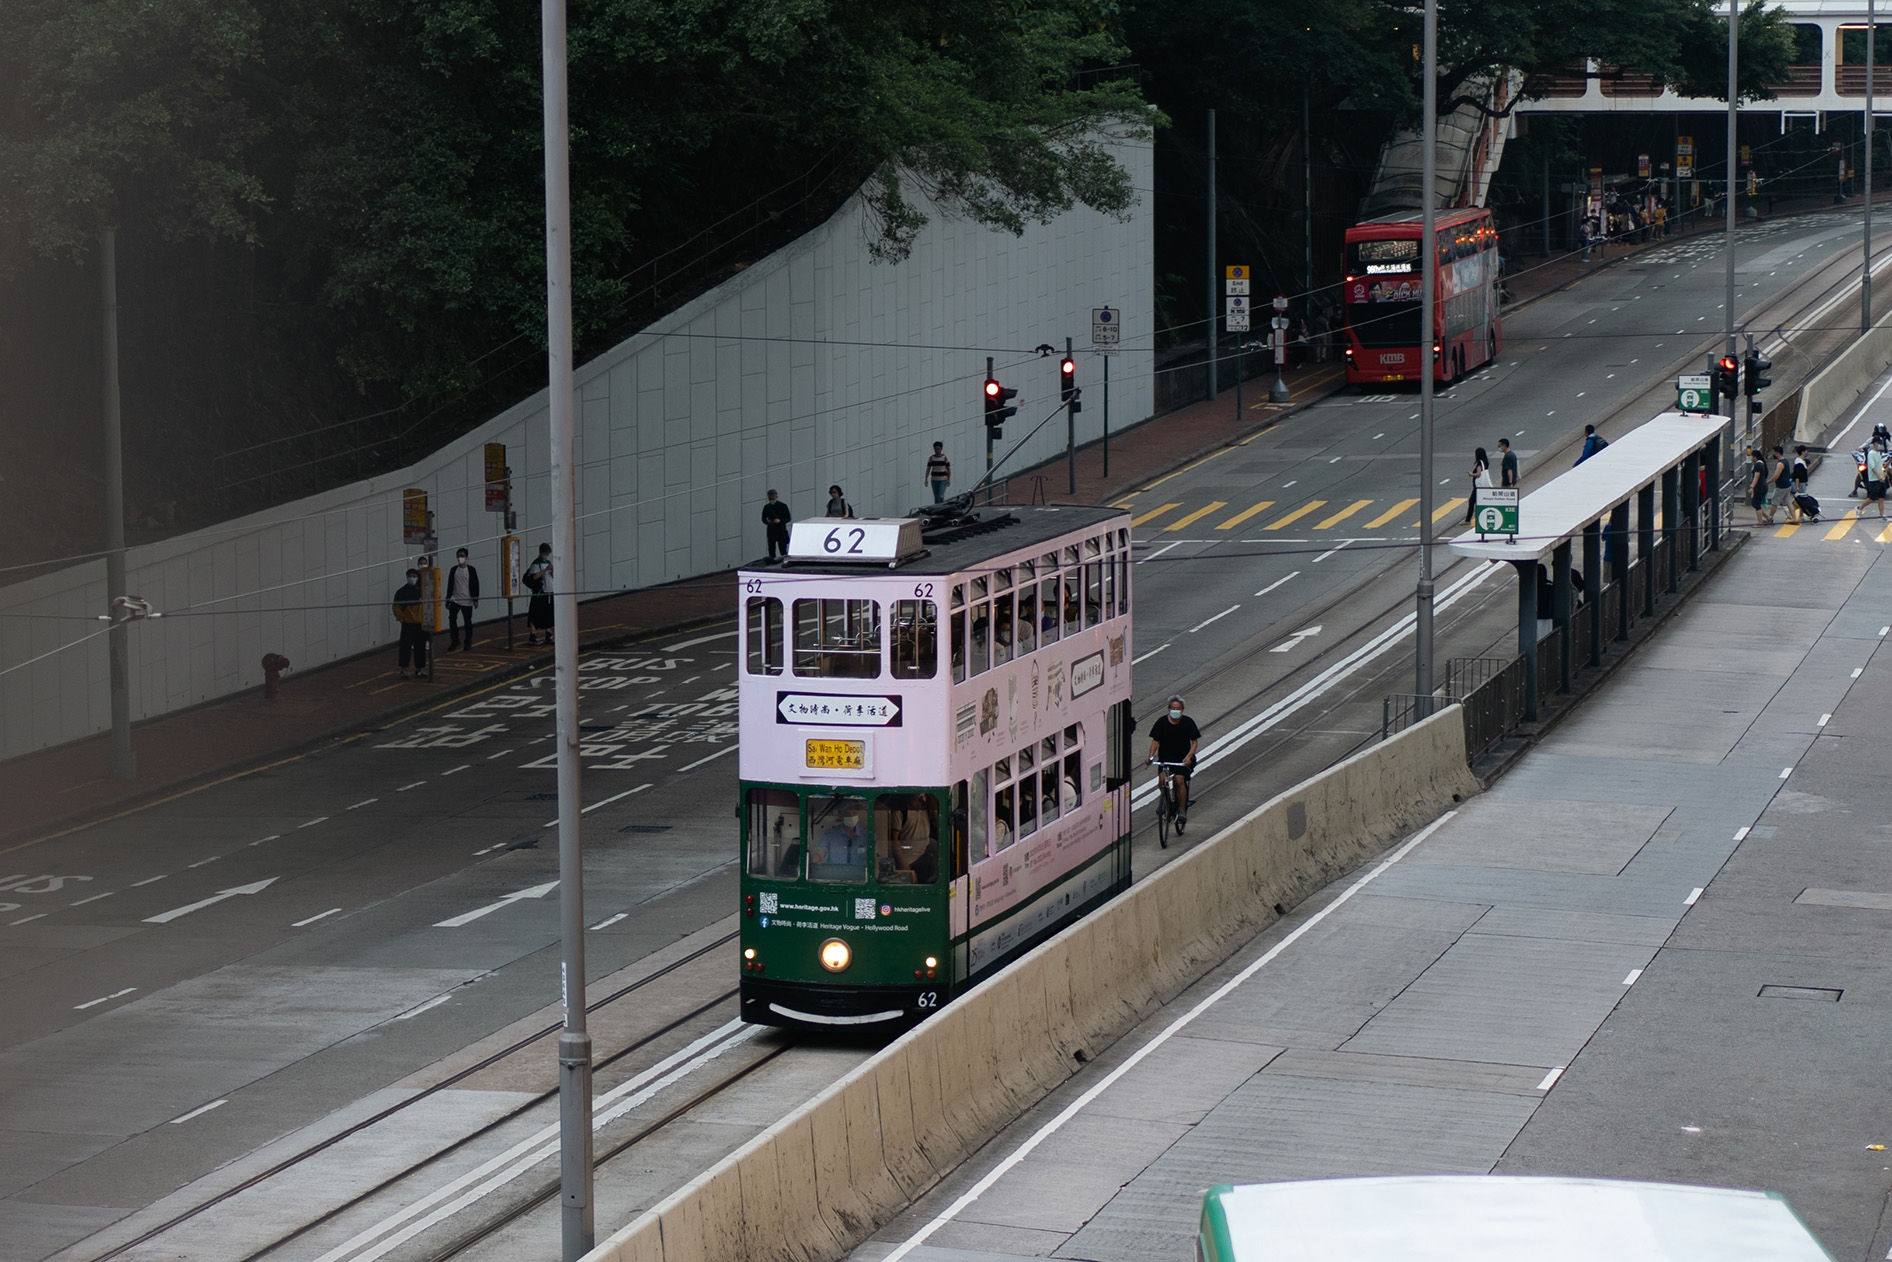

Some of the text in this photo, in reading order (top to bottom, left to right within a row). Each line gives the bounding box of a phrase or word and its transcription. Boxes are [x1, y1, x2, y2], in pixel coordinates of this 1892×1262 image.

[1379, 353, 1405, 365] KMB
[823, 527, 866, 554] 62
[746, 579, 762, 594] 62
[914, 583, 933, 598] 62
[577, 658, 695, 671] BUS
[808, 744, 863, 755] Sai Wan Ho Depot
[779, 903, 839, 912] www.heritage.gov.hk
[820, 922, 842, 931] Heritage
[843, 924, 860, 932] Vogue
[865, 924, 893, 932] Hollywood
[917, 992, 937, 1008] 62
